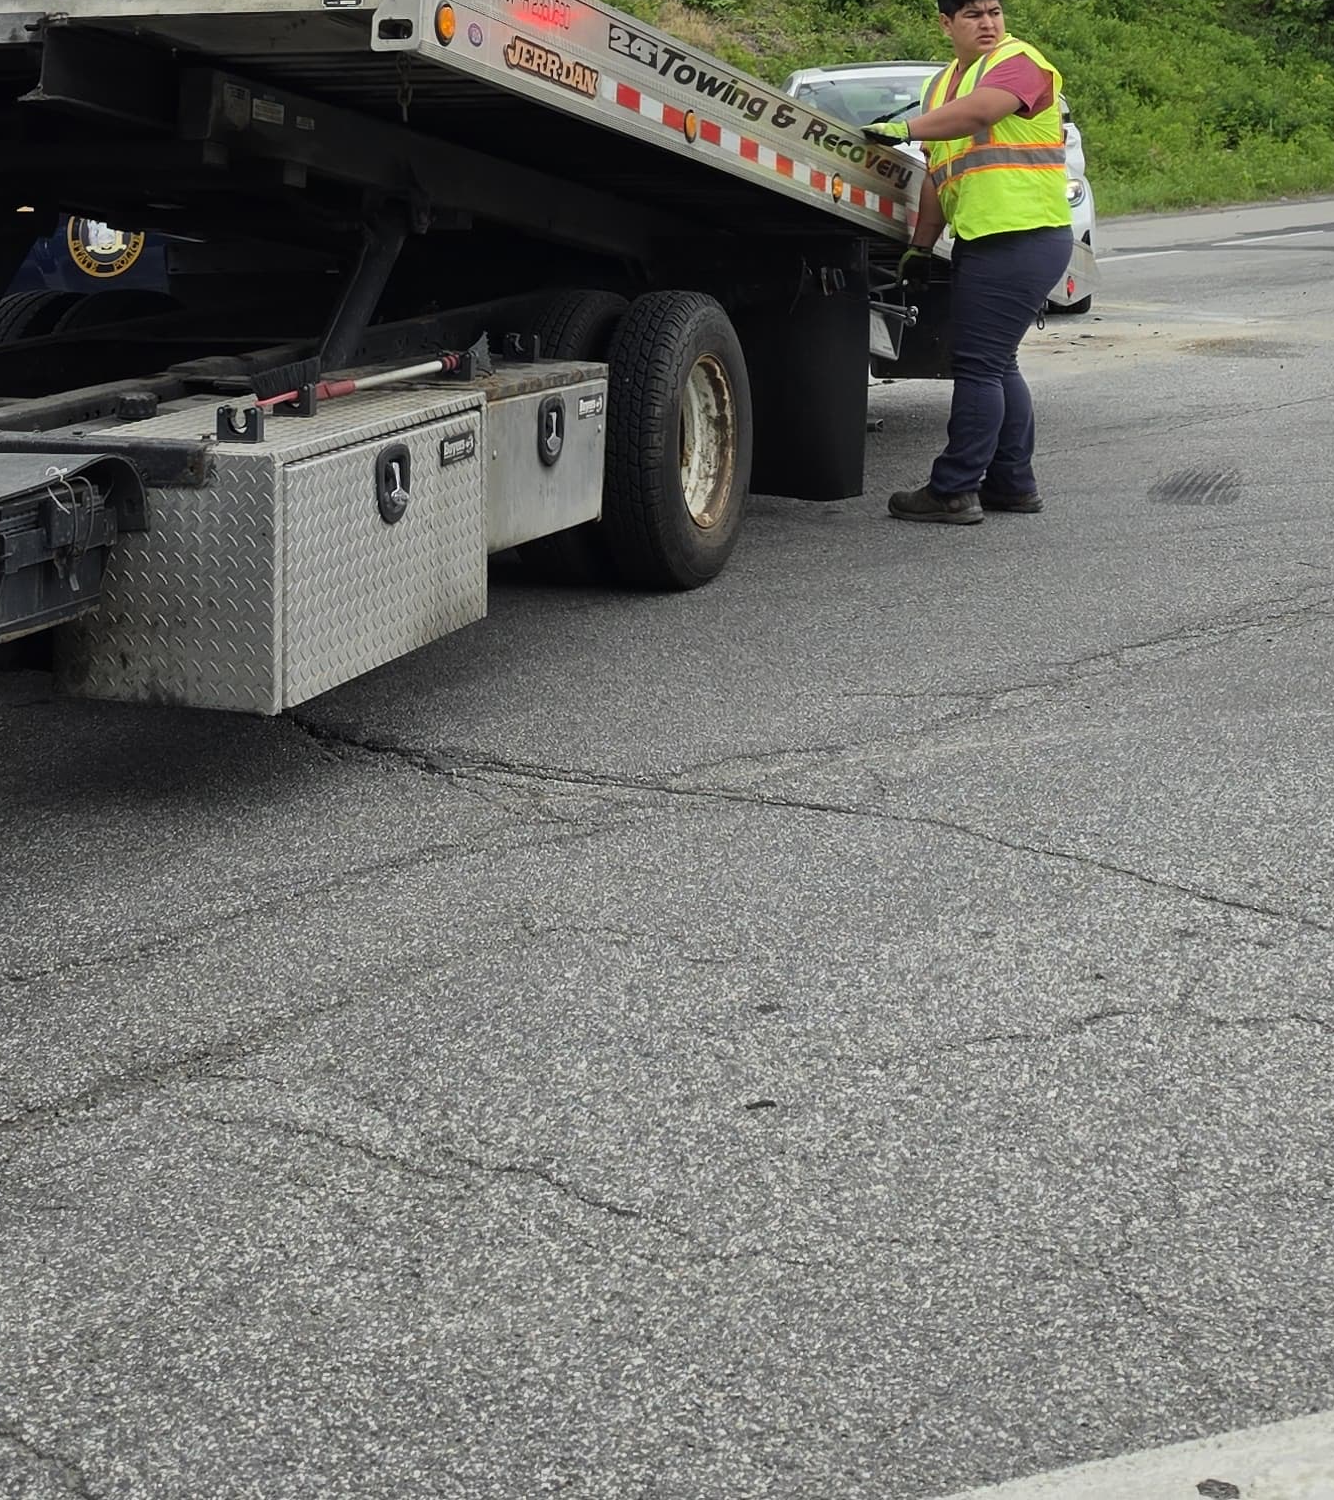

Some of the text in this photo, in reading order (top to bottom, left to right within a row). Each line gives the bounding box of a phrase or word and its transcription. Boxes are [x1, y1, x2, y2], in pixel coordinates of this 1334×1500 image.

[658, 47, 769, 122] Towing
[771, 104, 797, 129] &
[802, 120, 915, 191] Recovery
